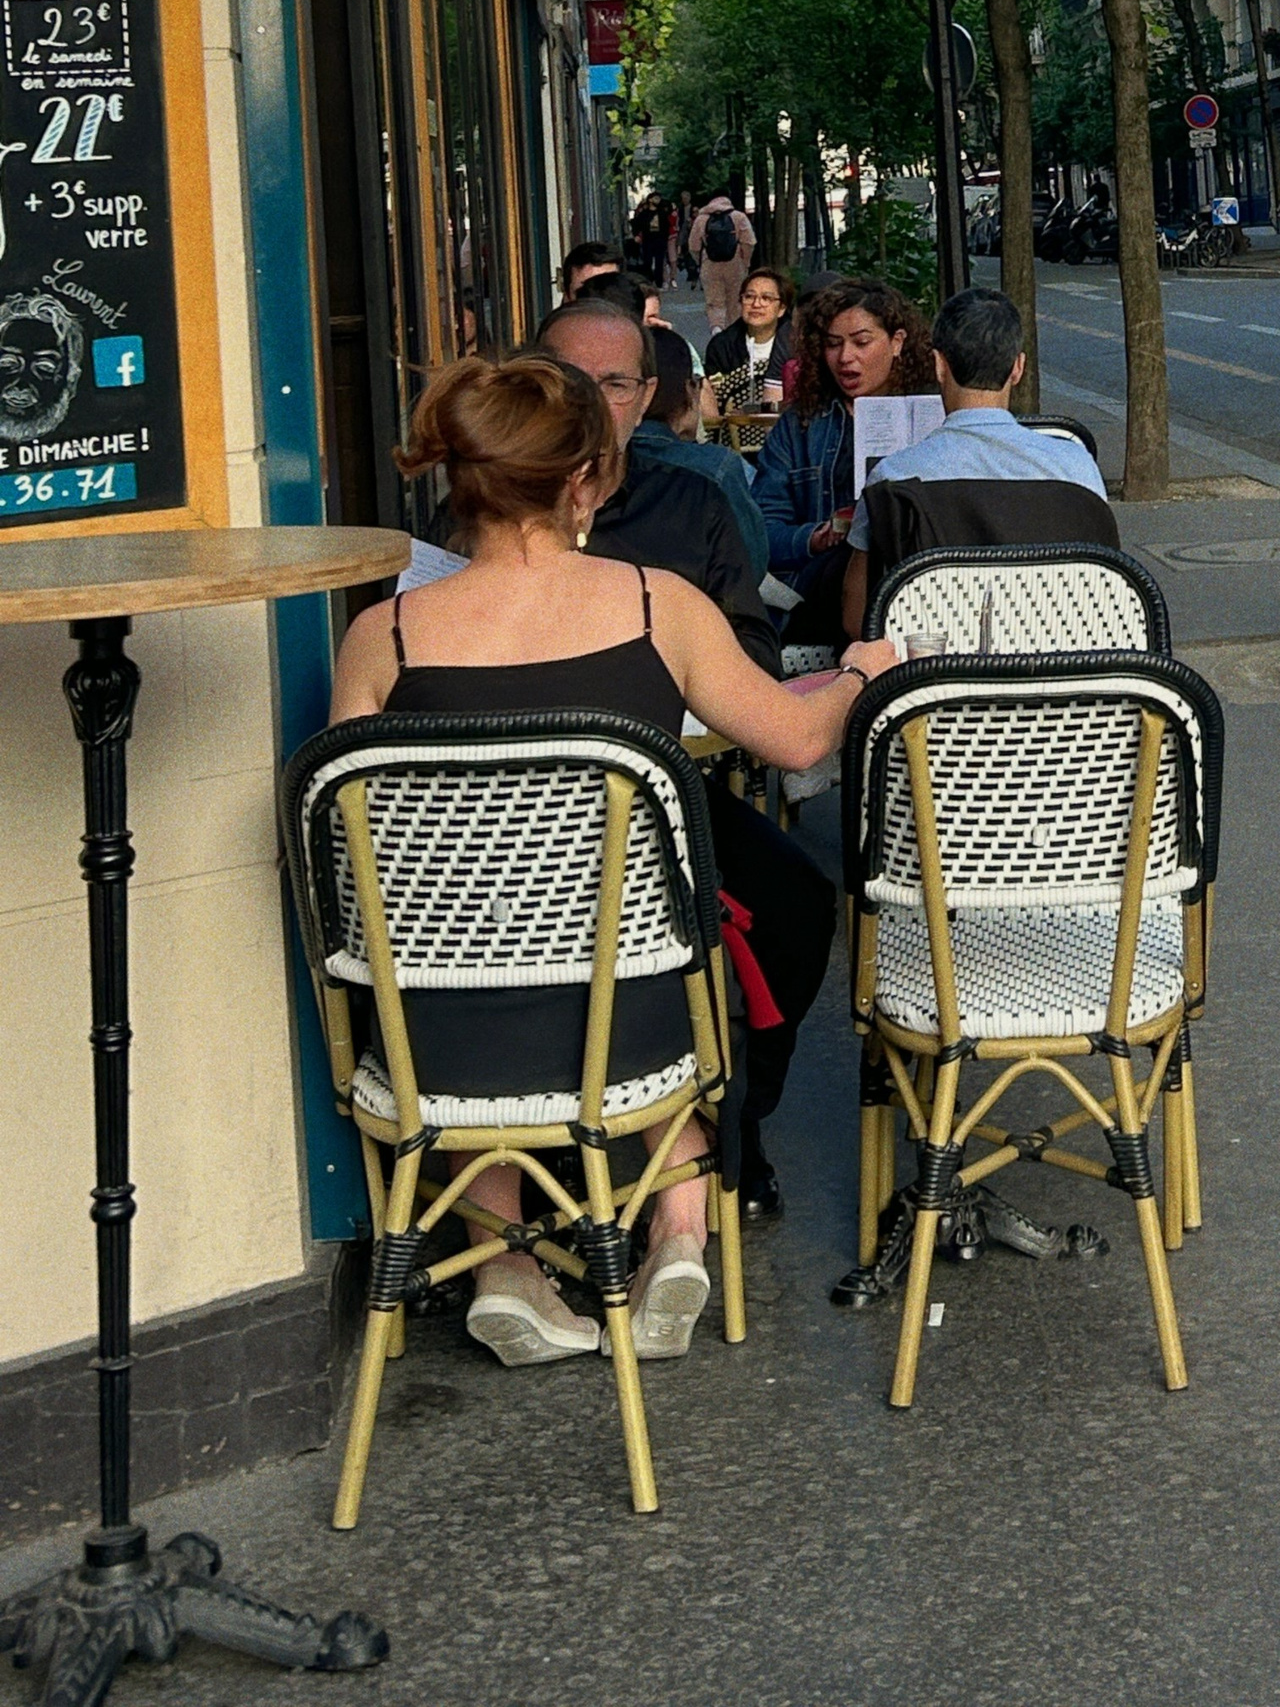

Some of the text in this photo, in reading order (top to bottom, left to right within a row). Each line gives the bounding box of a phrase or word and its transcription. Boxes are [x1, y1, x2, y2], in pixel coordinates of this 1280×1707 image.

[37, 3, 112, 47] 23€
[22, 42, 113, 64] le samedi
[55, 73, 135, 88] semaine
[31, 94, 125, 163] 22€
[85, 227, 148, 249] verre
[42, 257, 128, 330] Laurent
